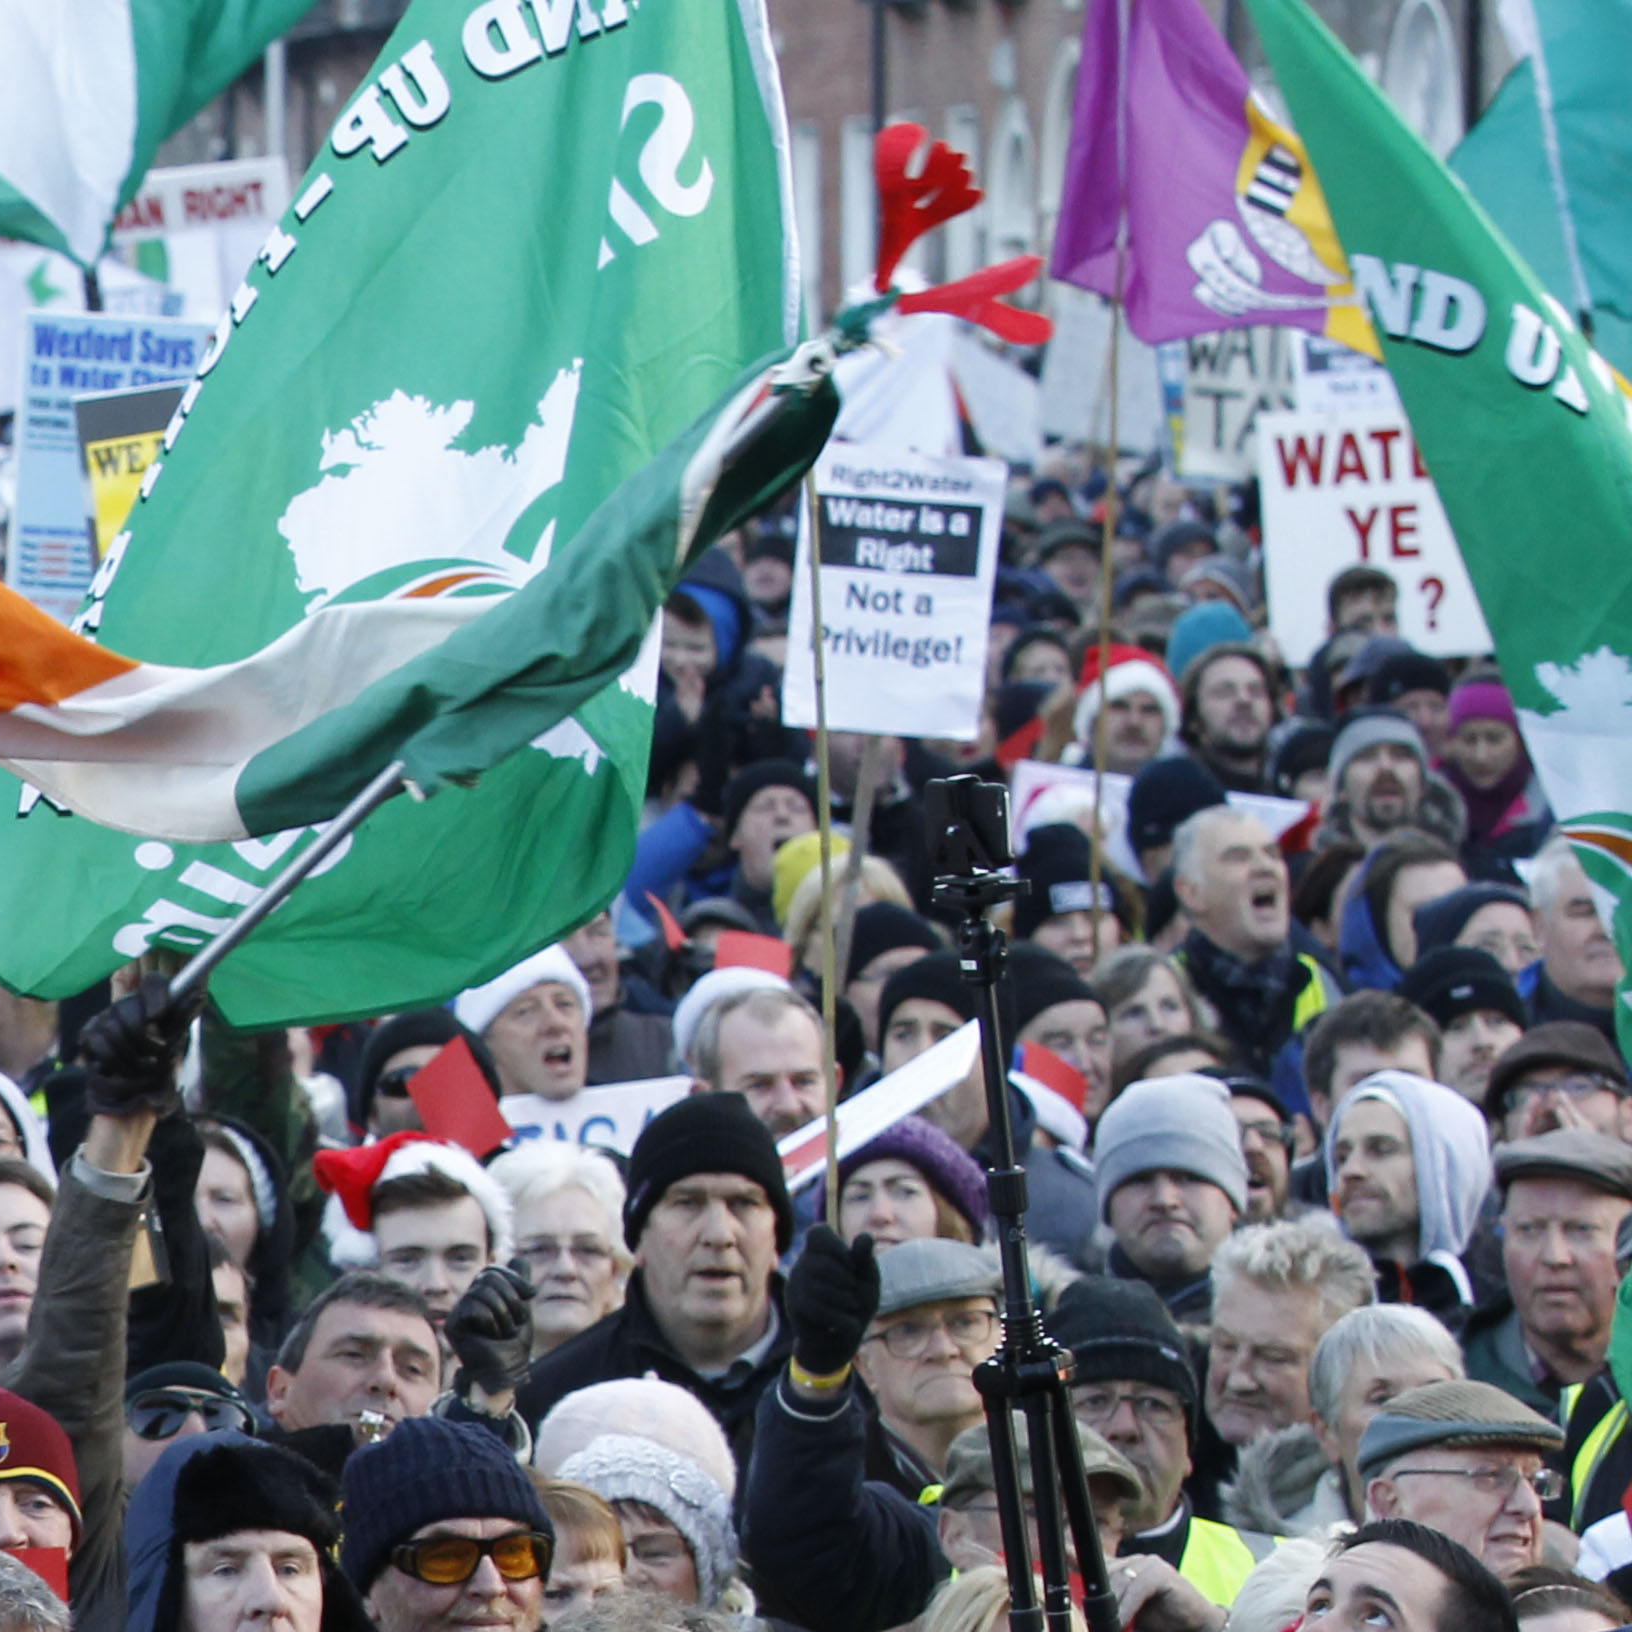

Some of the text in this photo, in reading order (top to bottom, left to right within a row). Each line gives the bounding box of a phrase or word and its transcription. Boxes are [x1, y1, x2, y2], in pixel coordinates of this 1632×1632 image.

[183, 181, 264, 221] RIGHT
[32, 323, 196, 369] Wexford Says
[93, 442, 146, 479] WE
[826, 499, 971, 536] Water is a
[1346, 505, 1420, 560] YE
[856, 536, 934, 574] Right
[846, 583, 933, 617] Not a
[1418, 577, 1445, 629] ?
